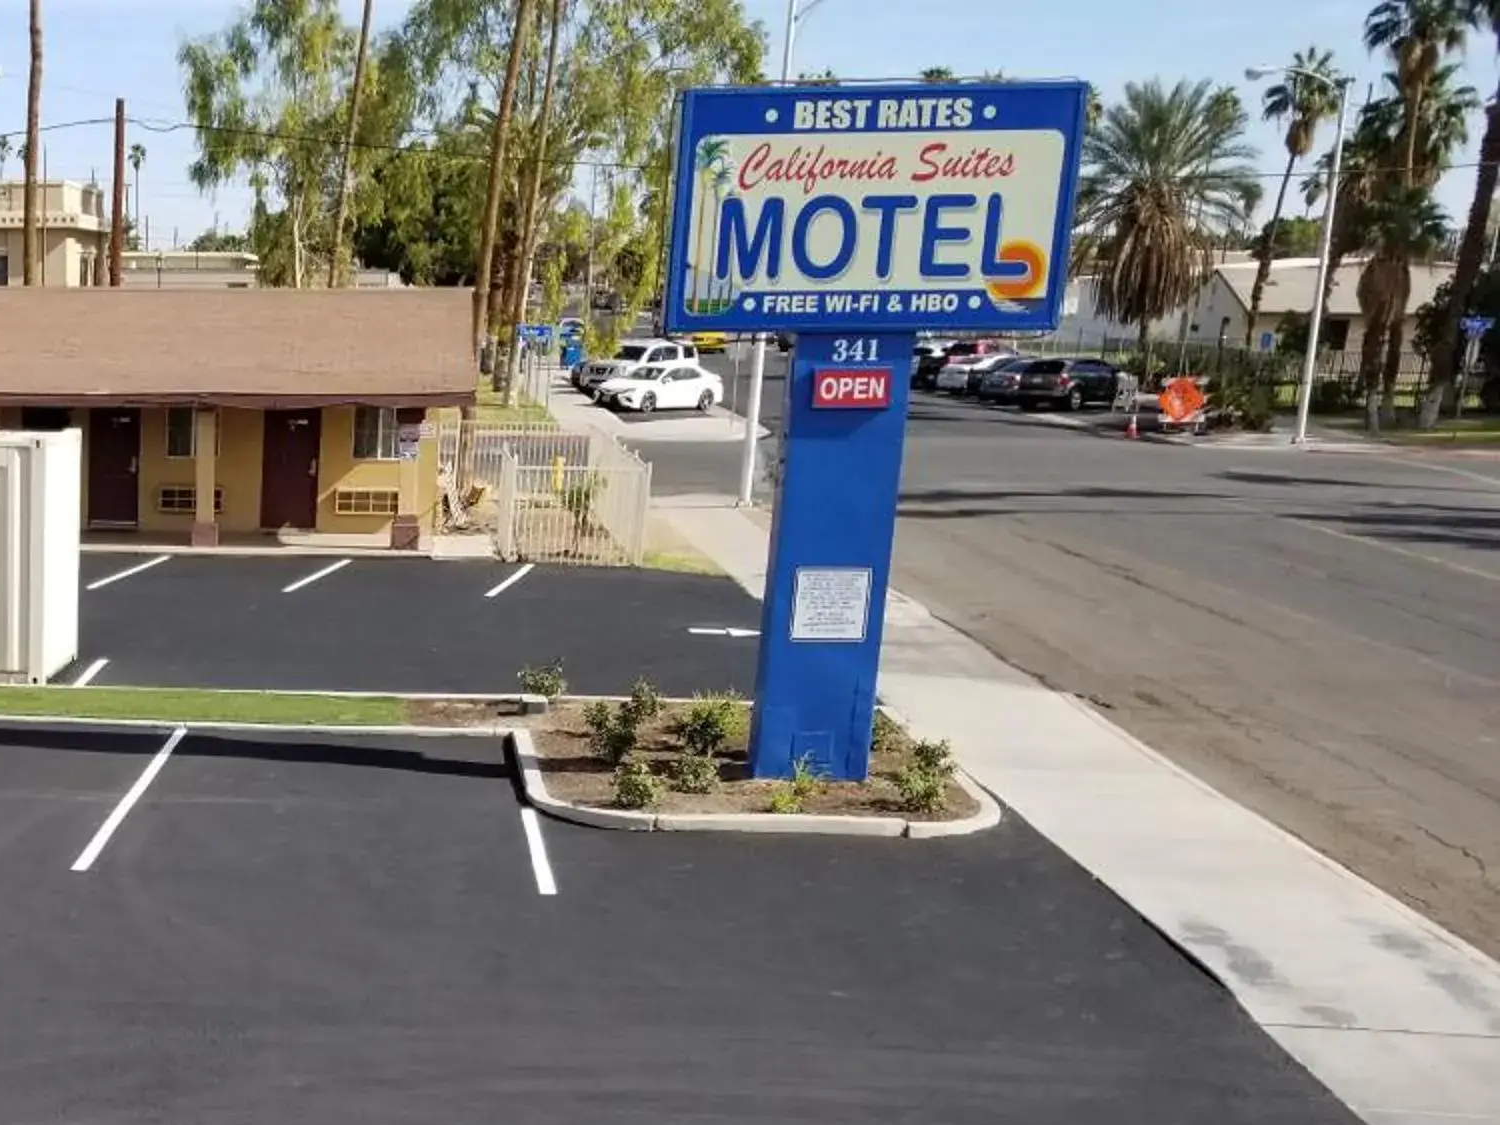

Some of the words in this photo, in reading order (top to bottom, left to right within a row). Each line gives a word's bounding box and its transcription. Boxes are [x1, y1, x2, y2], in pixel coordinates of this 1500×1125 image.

[793, 99, 871, 130] BEST
[877, 97, 973, 129] RATES
[738, 142, 898, 194] California
[911, 143, 1016, 182] Suites
[715, 192, 1029, 280] MOTEL
[762, 295, 819, 314] FREE
[825, 294, 880, 312] WI-FI
[886, 294, 904, 313] &
[910, 293, 959, 312] HBO
[832, 339, 879, 363] 341
[819, 376, 886, 400] OPEN
